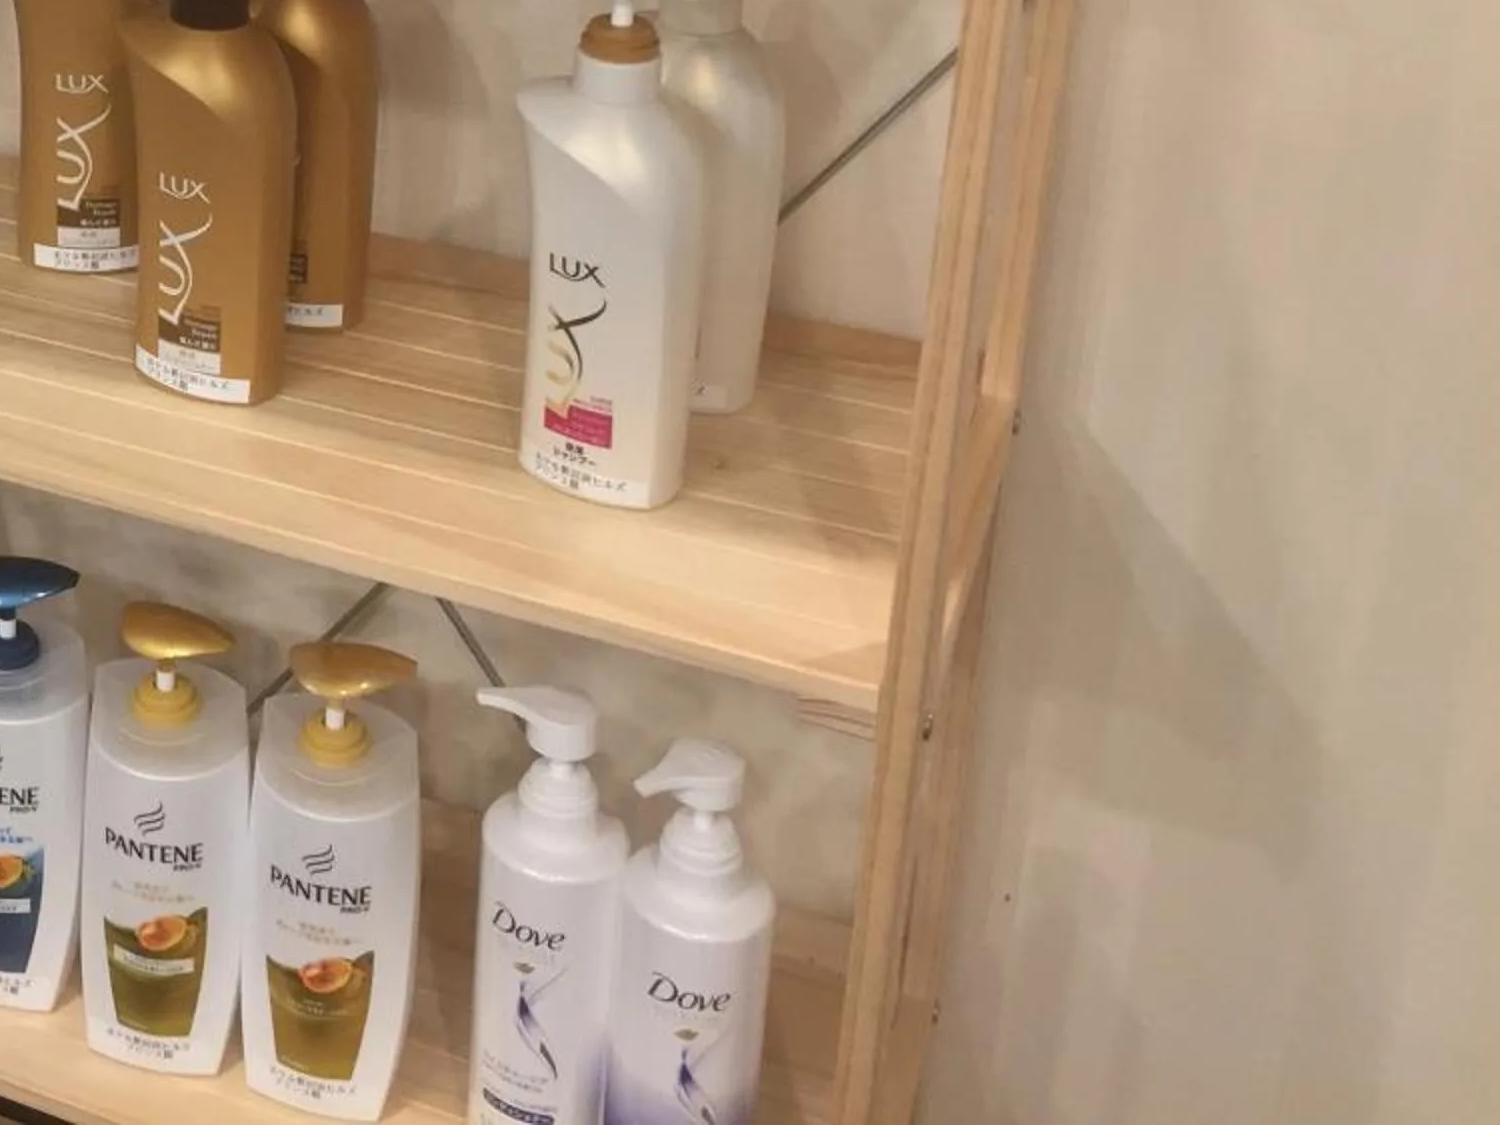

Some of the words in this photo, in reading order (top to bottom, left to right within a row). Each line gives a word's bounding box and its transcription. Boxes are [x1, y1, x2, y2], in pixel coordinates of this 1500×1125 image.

[55, 73, 109, 95] LUX
[55, 101, 114, 212] LUX
[158, 171, 211, 205] LUX
[157, 212, 214, 326] LUX
[549, 252, 607, 289] LUX
[104, 826, 204, 865] PANTENE
[269, 863, 373, 908] PANTENE
[491, 899, 566, 951] Dove
[647, 970, 732, 1013] Dove
